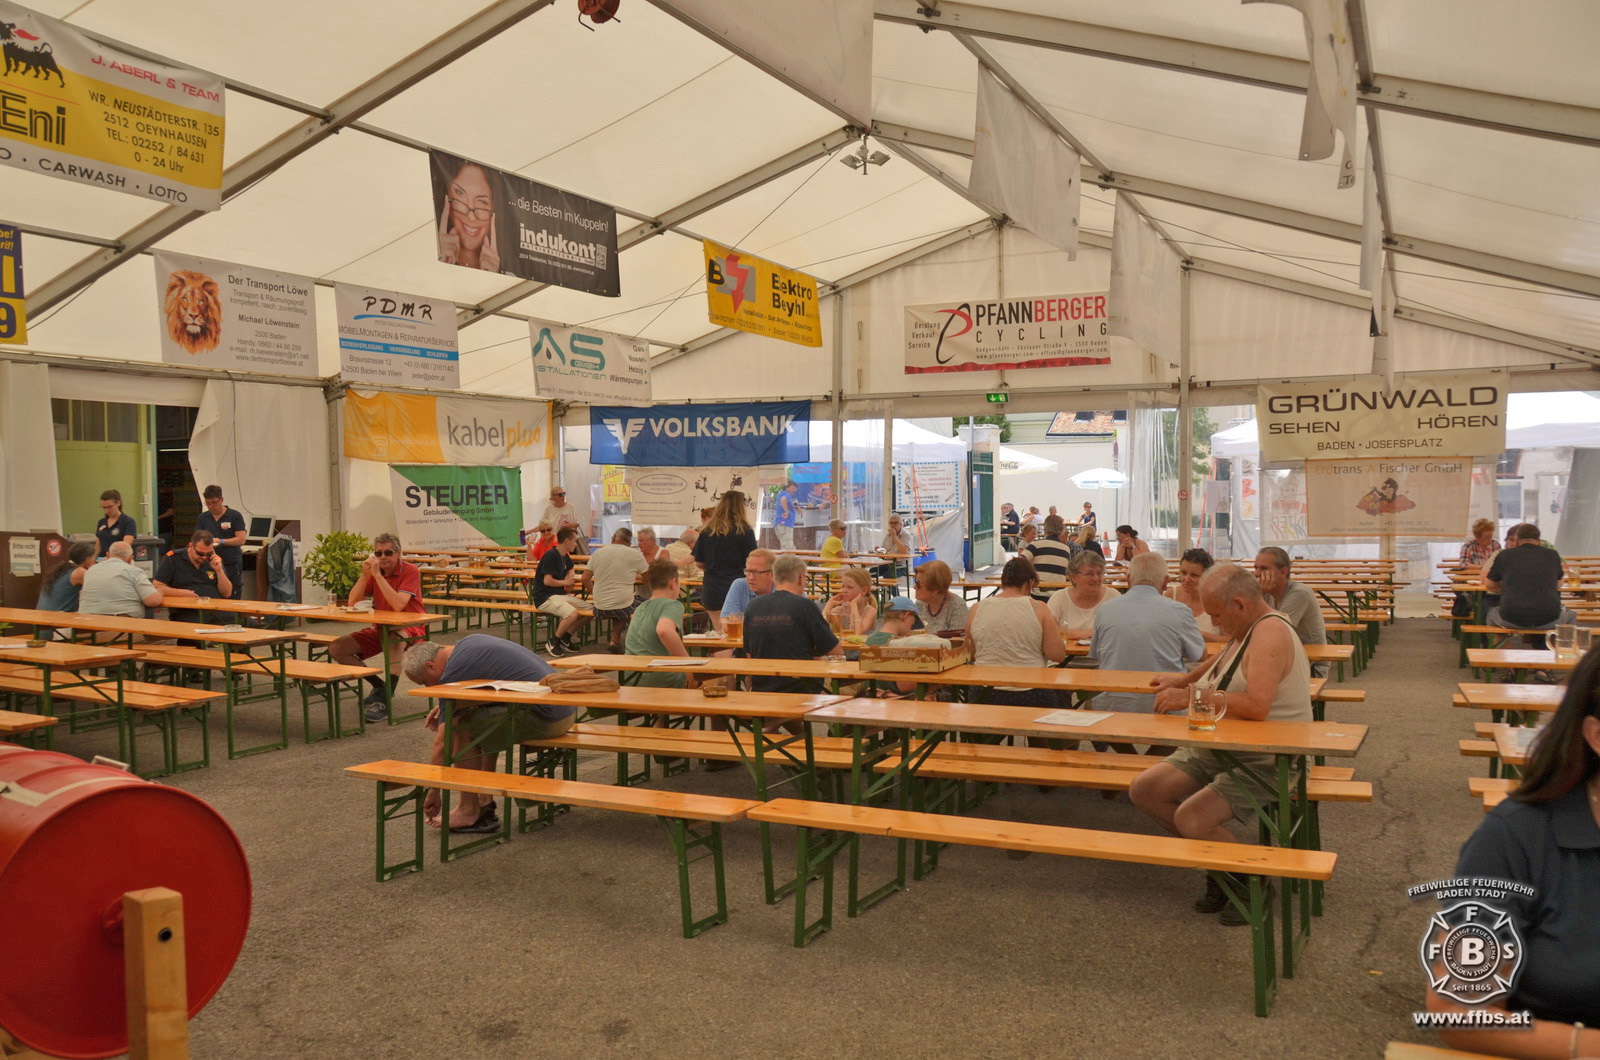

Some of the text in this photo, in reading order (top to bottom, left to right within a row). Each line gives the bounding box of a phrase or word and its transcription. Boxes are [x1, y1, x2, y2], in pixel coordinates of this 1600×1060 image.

[92, 56, 220, 103] J. ABERL & TEAM
[0, 89, 66, 146] Eni
[88, 90, 219, 136] WR. NEUSTÄDTERSTR. 135
[104, 112, 207, 149] 2512 OEYNHAUSEN
[132, 136, 164, 153] 02252
[177, 146, 188, 158] 84
[190, 151, 204, 164] 631
[153, 156, 166, 169] 24
[169, 161, 184, 173] Uhr
[39, 158, 126, 187] CARWASH
[149, 183, 188, 203] LOTTO
[532, 201, 562, 220] Besten
[564, 209, 574, 222] im
[574, 212, 609, 233] Kuppeln!
[520, 223, 596, 259] indukont
[708, 259, 725, 285] B
[228, 275, 308, 296] Der Transport Löwe
[772, 292, 805, 317] Beyhl
[976, 296, 1107, 327] PFANNBERGER
[238, 314, 300, 329] Michael Löwenstein
[976, 323, 1107, 343] CYCLING
[270, 332, 286, 340] Baden
[361, 366, 378, 375] Baden
[537, 365, 607, 380] STALLATIONEN
[1268, 386, 1498, 414] GRÜNWALD
[649, 415, 795, 438] VOLKSBANK
[1269, 421, 1340, 435] SEHEN
[1418, 414, 1498, 429] HÖREN
[1317, 438, 1443, 451] BADEN JOSEFSPLATZ
[1315, 466, 1362, 475] Erdtrans
[1380, 463, 1420, 473] Fischer
[1425, 463, 1462, 473] GmbH
[405, 485, 508, 508] STEURER
[607, 484, 630, 497] KLA
